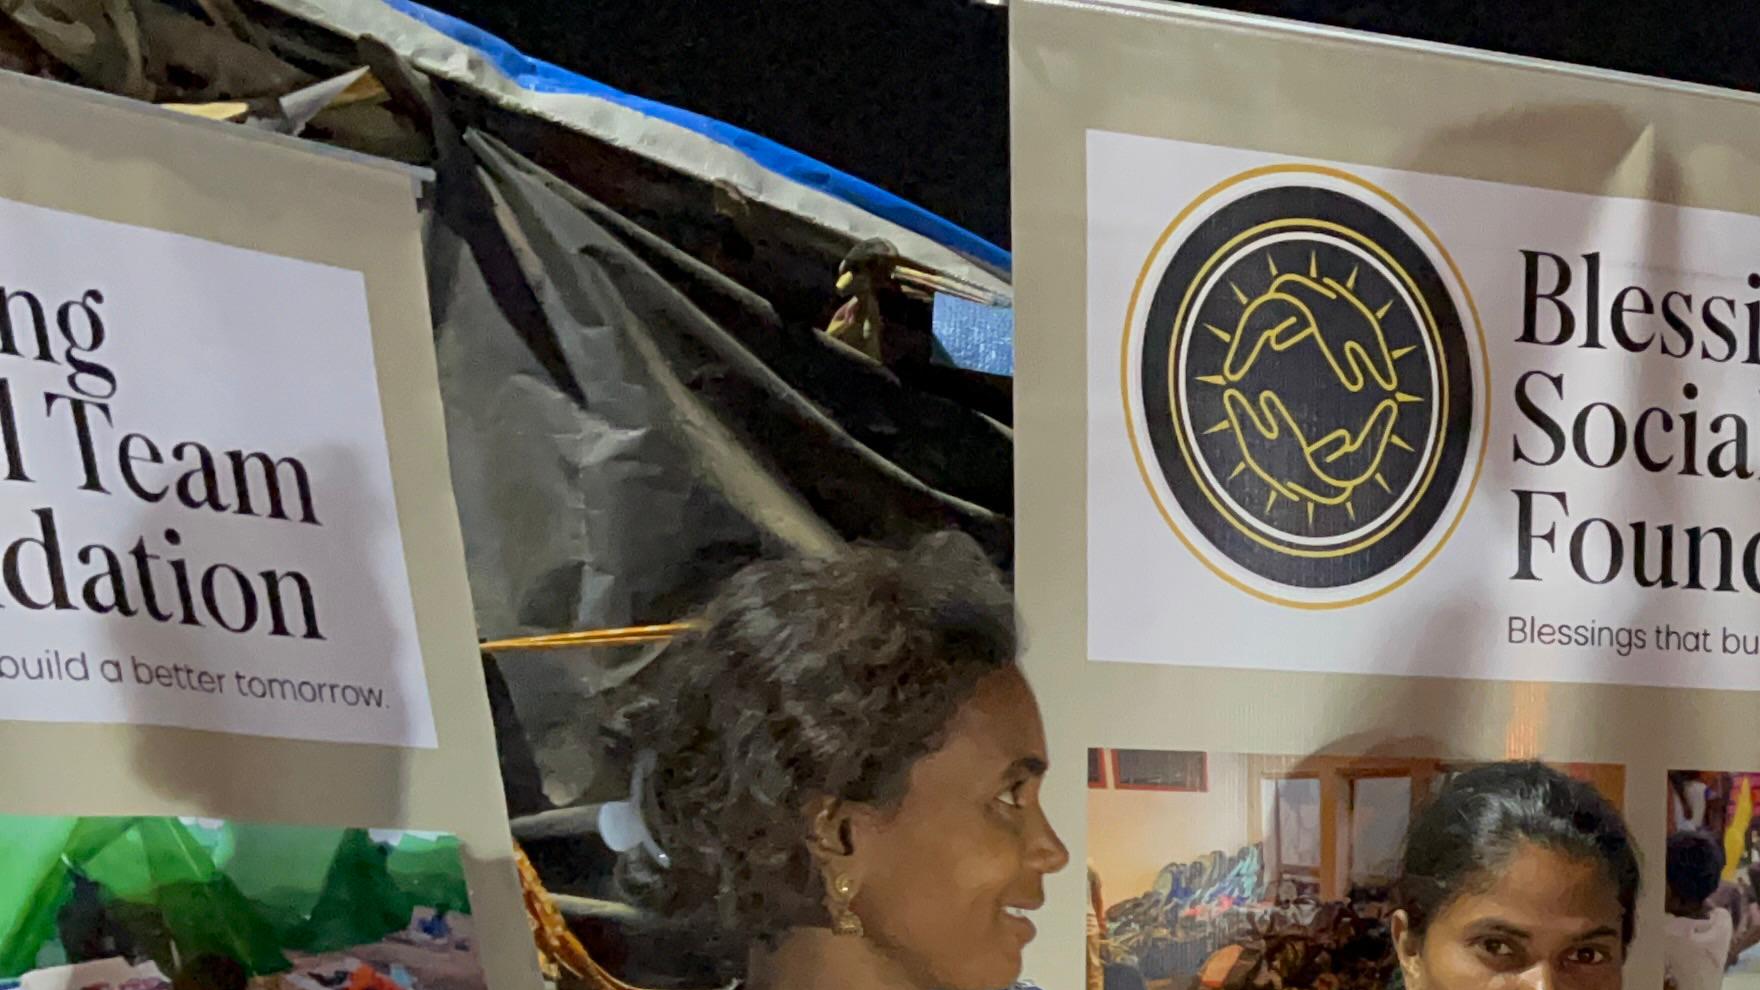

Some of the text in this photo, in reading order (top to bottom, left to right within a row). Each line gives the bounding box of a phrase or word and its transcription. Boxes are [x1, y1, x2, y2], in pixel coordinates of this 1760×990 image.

[43, 390, 323, 526] Team
[0, 507, 327, 640] dation
[100, 658, 123, 684] a
[131, 655, 226, 695] better
[235, 671, 391, 710] tomorrow.
[1507, 615, 1647, 657] Blessings
[1655, 624, 1712, 653] that
